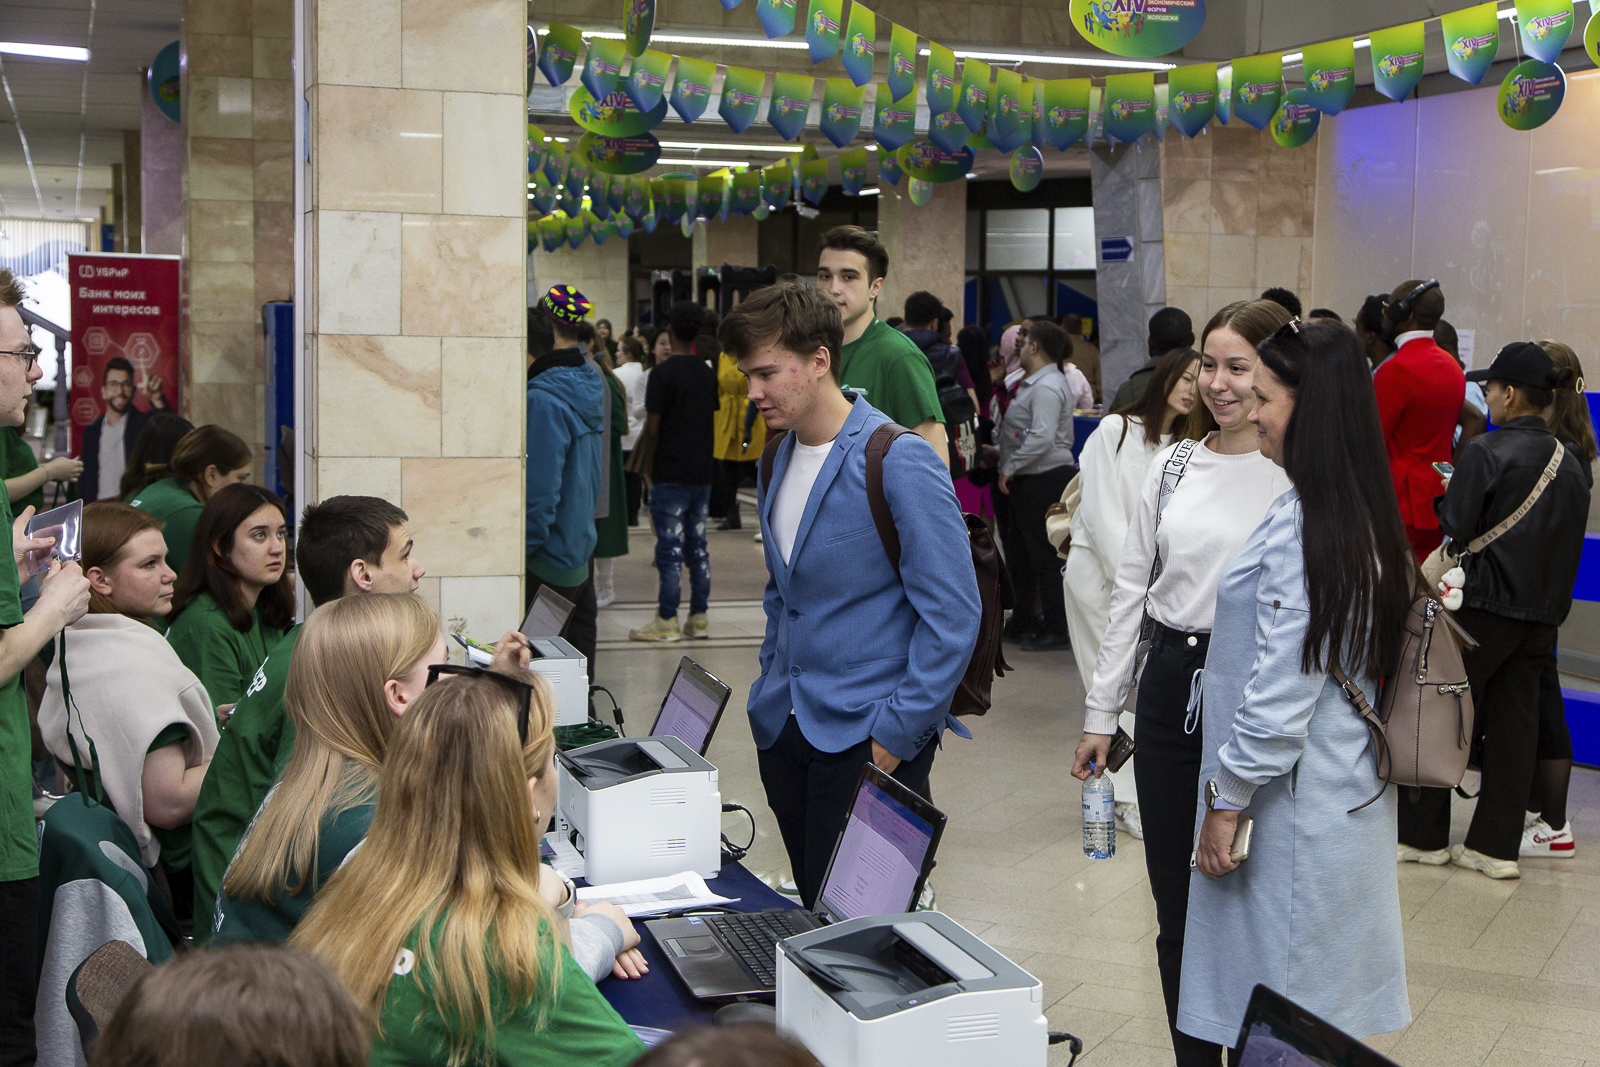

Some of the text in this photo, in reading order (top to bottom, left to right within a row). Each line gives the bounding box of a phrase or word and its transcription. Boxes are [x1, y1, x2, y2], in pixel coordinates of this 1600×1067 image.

[1535, 16, 1552, 30] XIV
[1461, 37, 1478, 50] XIV
[1387, 55, 1403, 67] XIV
[1517, 78, 1535, 98] XIV
[78, 287, 146, 300] Банк моих
[92, 304, 160, 317] интересов
[1512, 495, 1536, 521] GUESS
